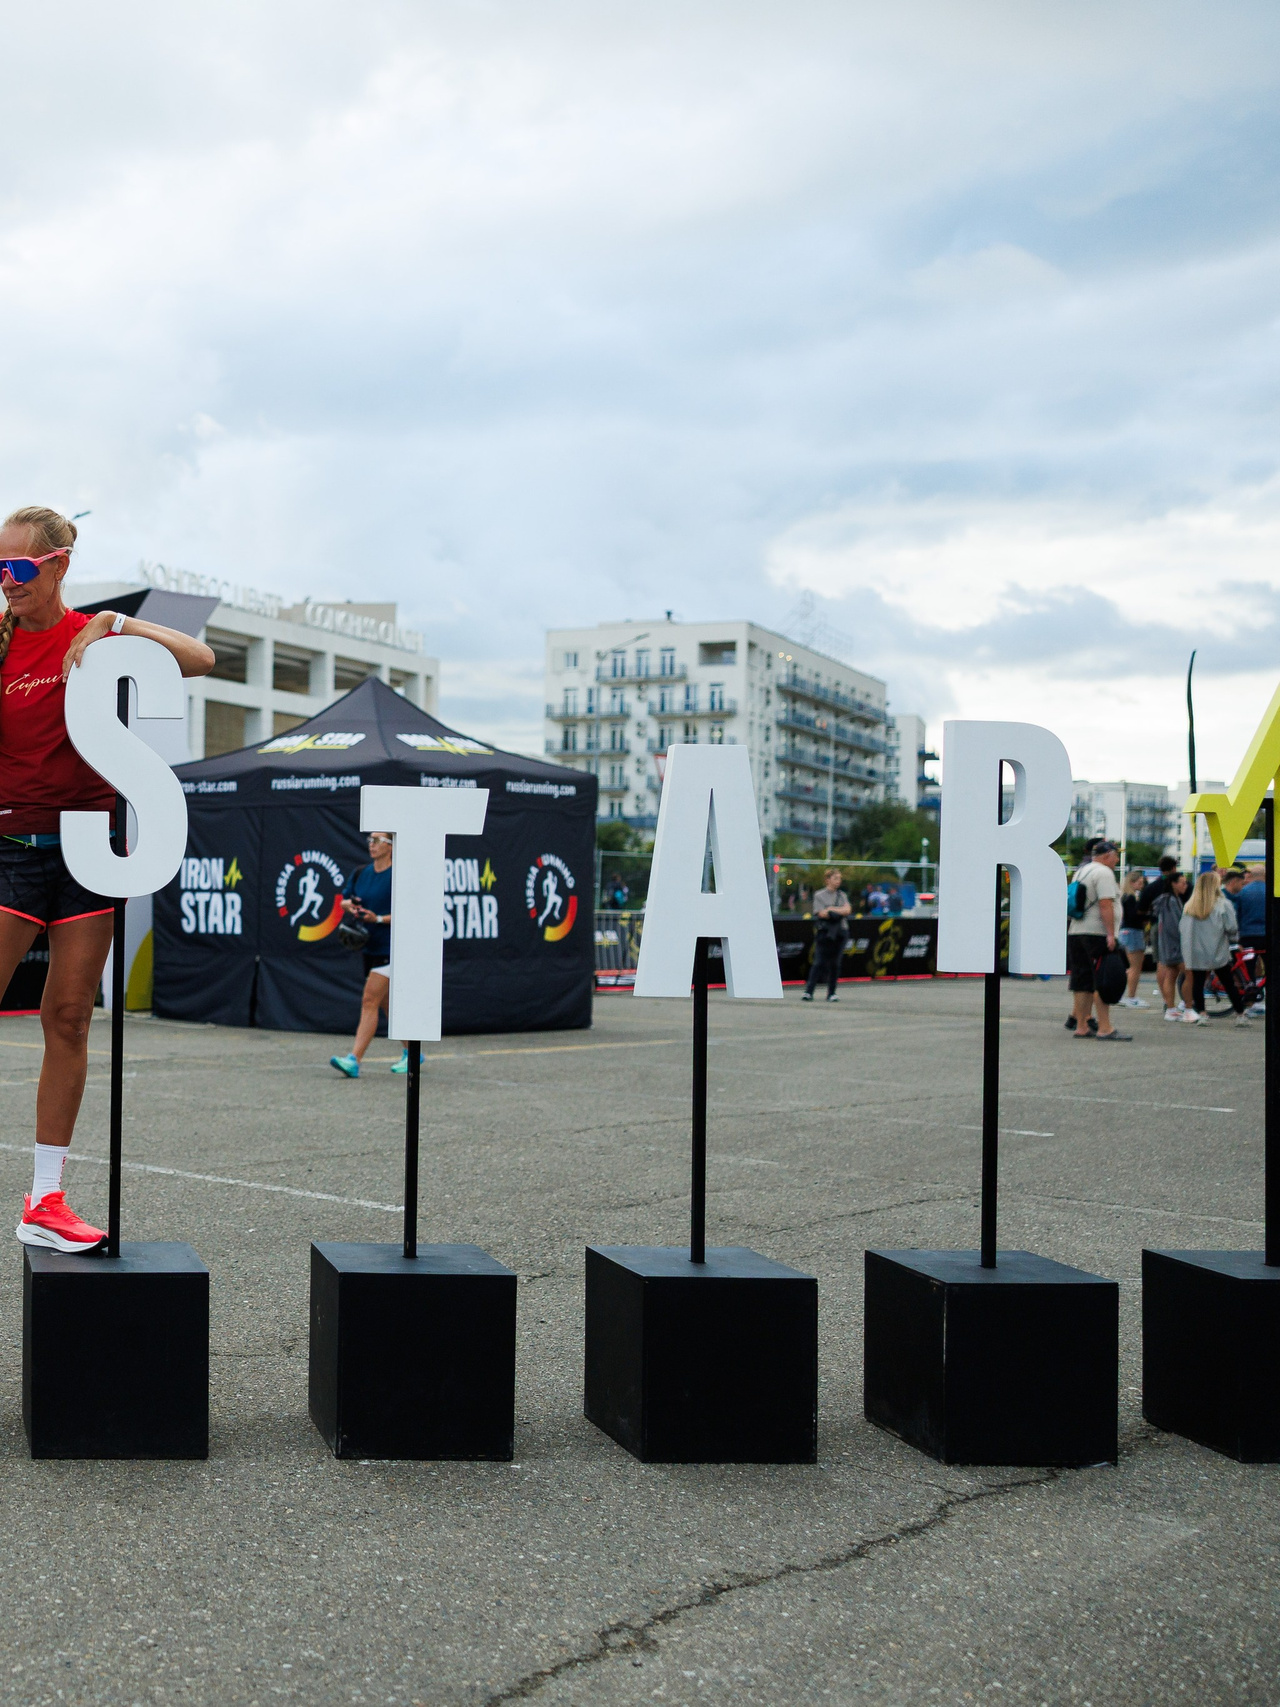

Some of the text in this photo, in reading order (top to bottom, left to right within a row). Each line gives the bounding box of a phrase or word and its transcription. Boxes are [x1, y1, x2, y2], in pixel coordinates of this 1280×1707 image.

[180, 780, 237, 793] ron-star.com
[271, 774, 361, 791] russiarunning.com
[180, 857, 224, 891] IRON
[444, 858, 480, 893] RON
[180, 891, 243, 936] STAR
[443, 894, 499, 940] STAR
